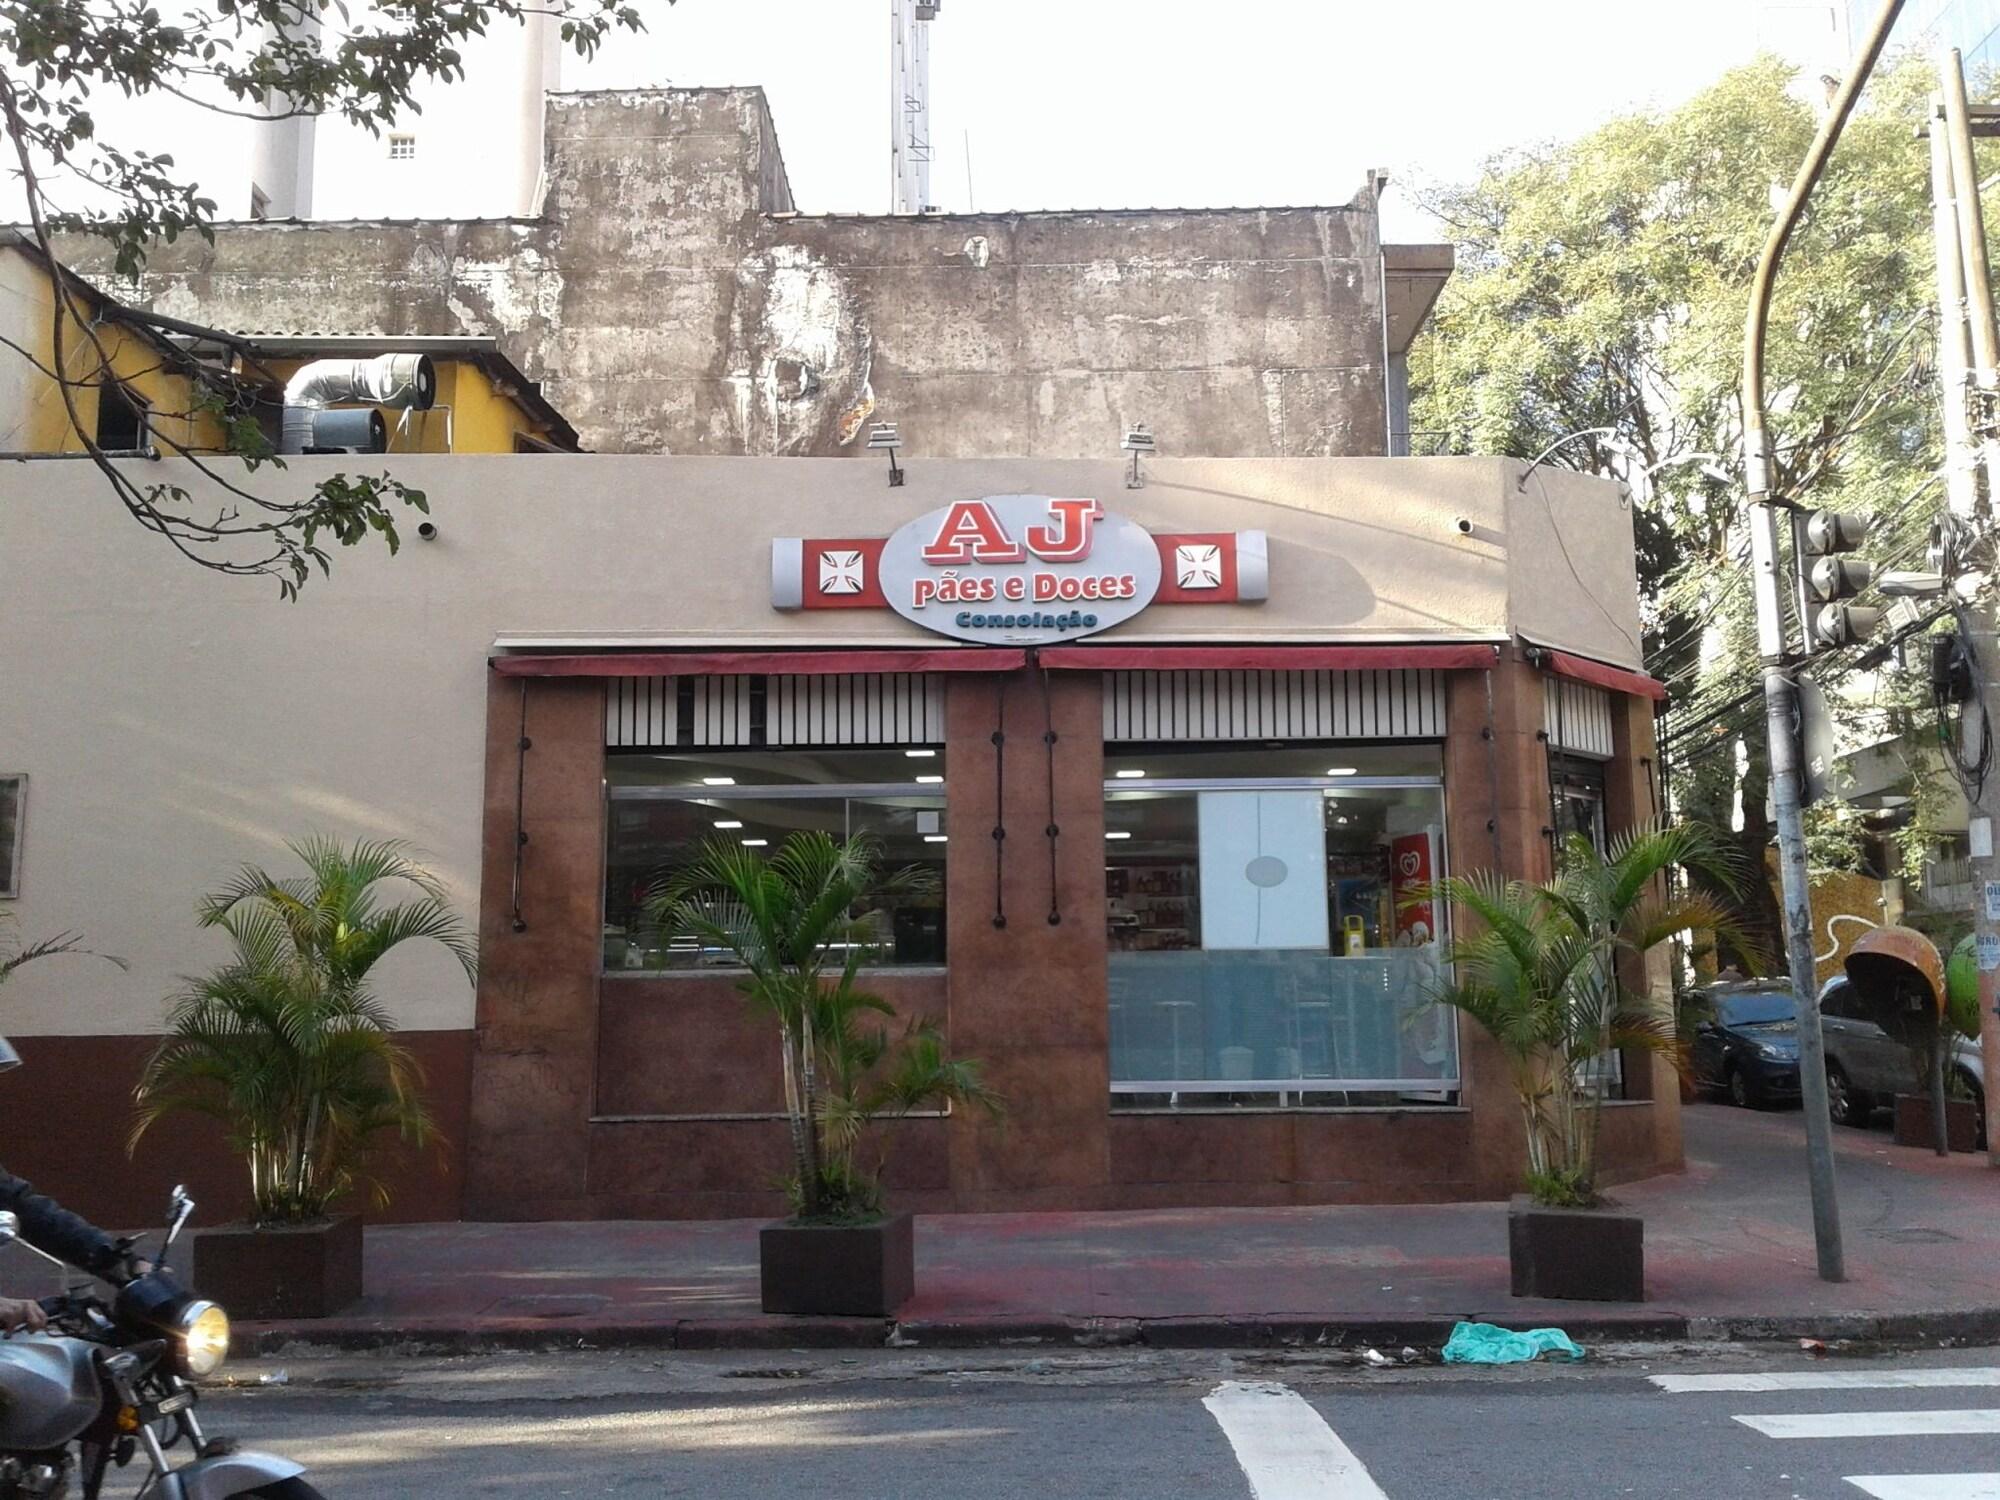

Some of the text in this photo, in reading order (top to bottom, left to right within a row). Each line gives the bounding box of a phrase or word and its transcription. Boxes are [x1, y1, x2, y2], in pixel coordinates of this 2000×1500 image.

[912, 570, 1137, 608] pães e Doces
[955, 610, 1099, 631] Consolação
